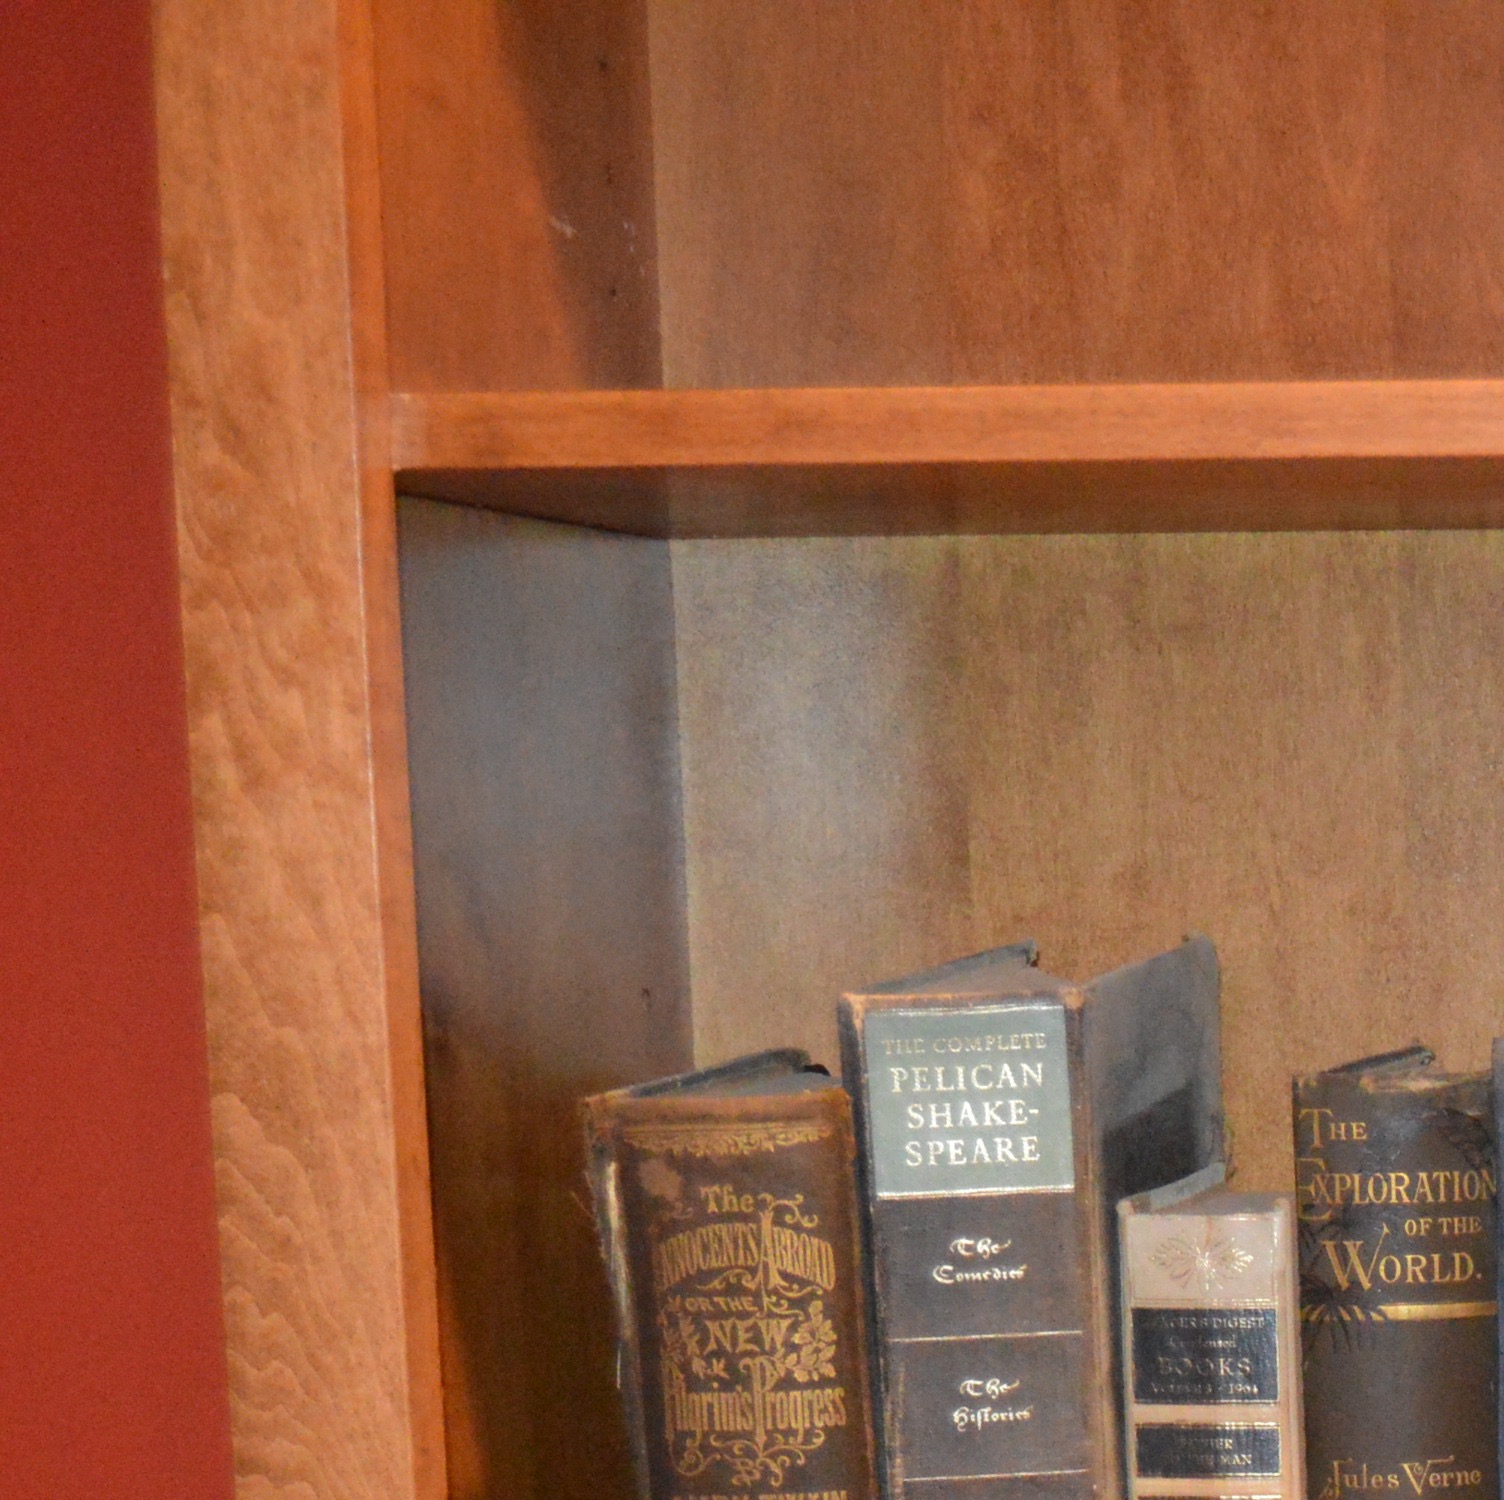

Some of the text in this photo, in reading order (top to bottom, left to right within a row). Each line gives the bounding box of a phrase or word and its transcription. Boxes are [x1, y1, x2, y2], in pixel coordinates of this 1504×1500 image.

[881, 1032, 1047, 1055] THE COMPLETE
[889, 1062, 1045, 1095] PELICAN
[906, 1099, 1040, 1131] SHAKE-
[1299, 1108, 1368, 1149] THE
[904, 1136, 1041, 1167] SPEARE
[700, 1184, 755, 1214] The
[1297, 1157, 1498, 1223] EXPLORATION
[1404, 1217, 1482, 1236] OF THE
[949, 1237, 1011, 1258] The
[1322, 1222, 1483, 1292] WORLD.
[932, 1263, 1027, 1284] Comedies
[702, 1317, 795, 1354] NEW
[958, 1377, 1020, 1398] The
[952, 1405, 1032, 1430] Histories
[1319, 1454, 1482, 1500] Jules Verne
